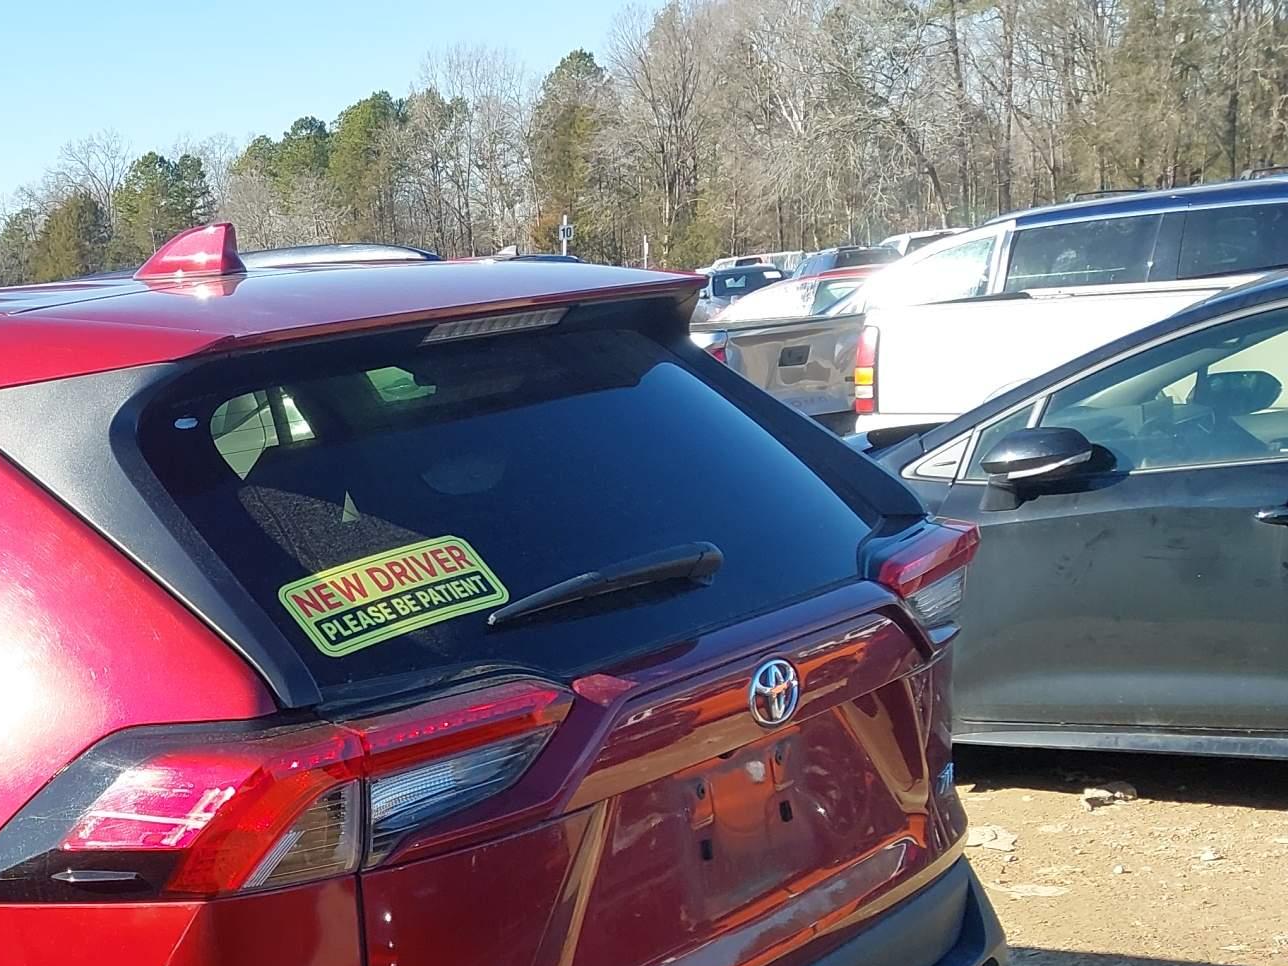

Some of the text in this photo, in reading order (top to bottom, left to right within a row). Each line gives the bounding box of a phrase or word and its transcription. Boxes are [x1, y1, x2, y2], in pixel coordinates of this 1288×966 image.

[290, 545, 476, 618] NEW DRIVER
[320, 574, 489, 641] PLEASE BE PATIENT
